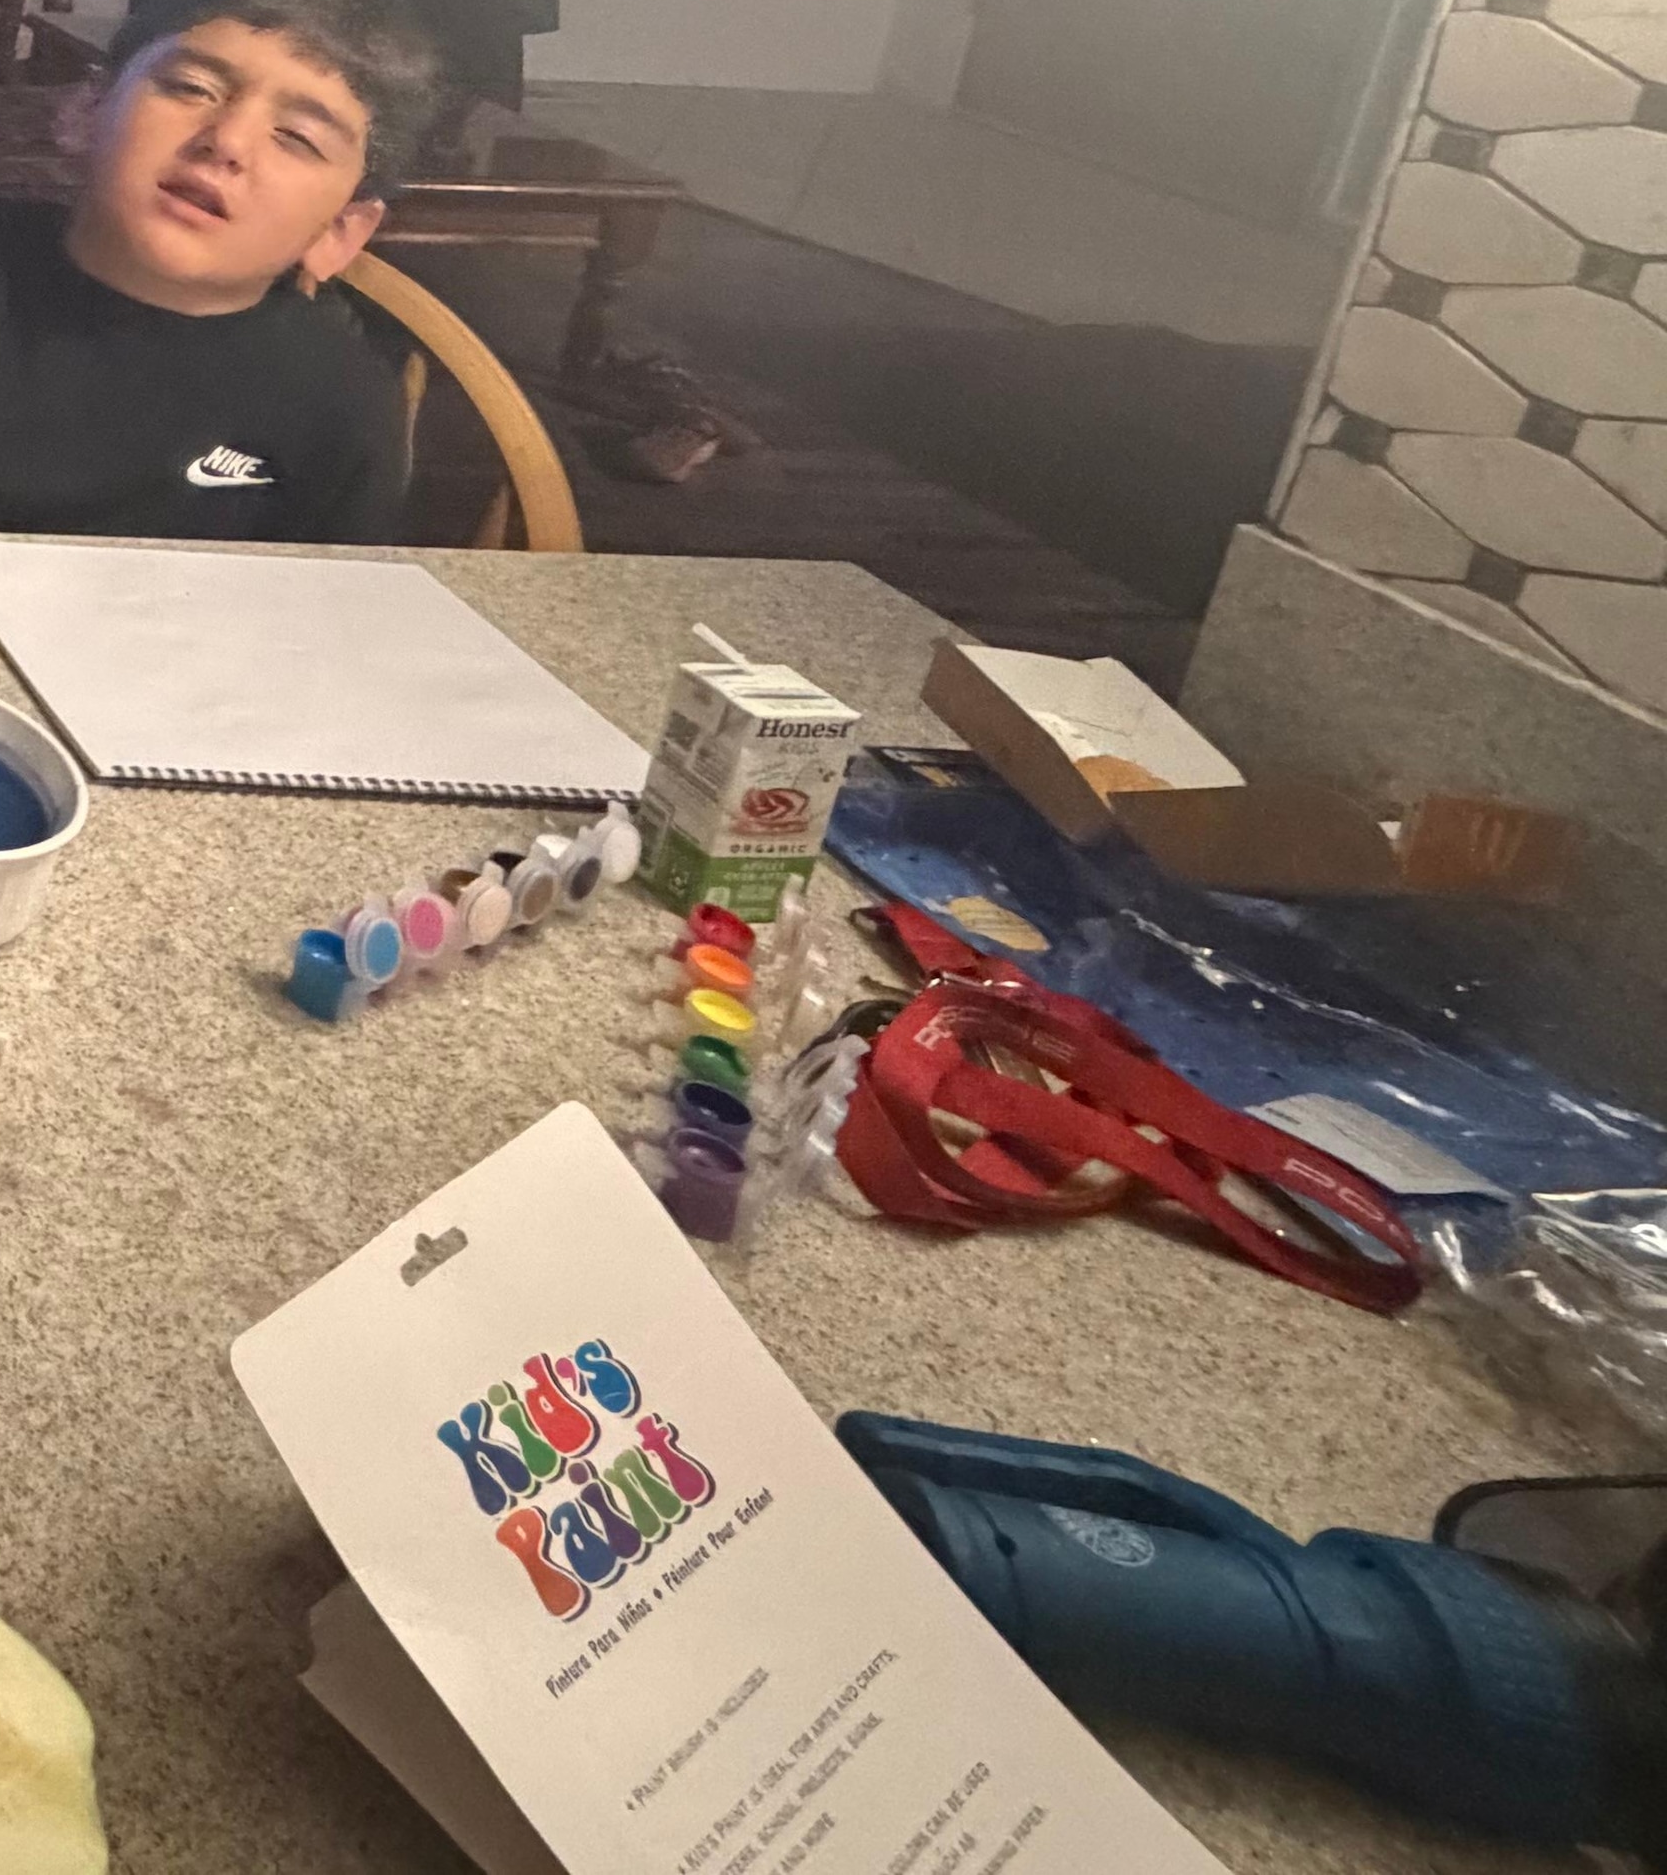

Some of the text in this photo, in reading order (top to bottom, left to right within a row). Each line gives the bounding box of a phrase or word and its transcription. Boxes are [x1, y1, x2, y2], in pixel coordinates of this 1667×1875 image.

[203, 445, 267, 478] NIKE
[755, 718, 854, 739] Honest
[729, 843, 806, 855] ORGANIC
[436, 1338, 642, 1520] Kid's
[495, 1411, 716, 1623] Paint
[545, 1486, 775, 1700] Pintura Para Niños Peinture Pour Enfant
[834, 1684, 859, 1711] AND
